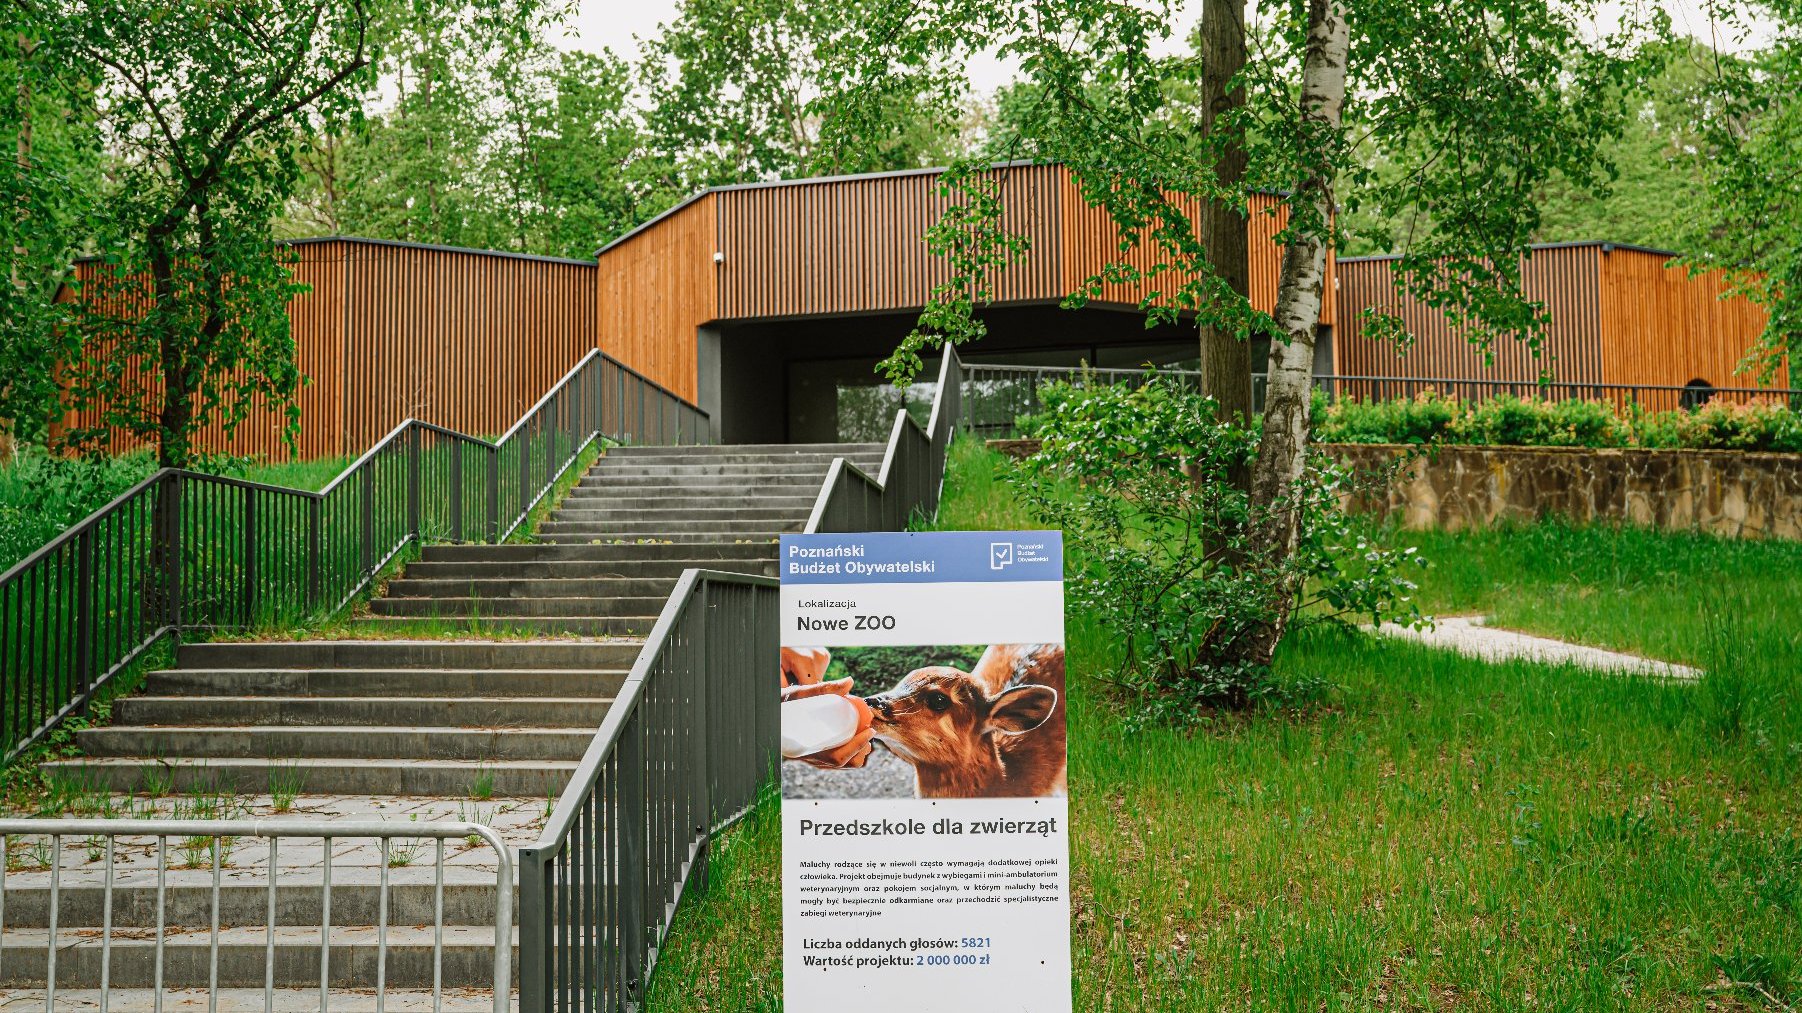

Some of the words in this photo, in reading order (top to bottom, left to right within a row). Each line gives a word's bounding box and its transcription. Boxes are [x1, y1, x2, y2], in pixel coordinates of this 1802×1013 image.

[790, 545, 864, 557] Poznański
[790, 562, 840, 573] Budżet
[845, 561, 934, 575] Obywatelski
[799, 600, 856, 609] Lokalizacja
[798, 617, 848, 630] Nowe
[855, 616, 895, 630] ZOO
[801, 819, 925, 835] Przedszkole
[933, 819, 962, 834] dla
[970, 818, 1057, 837] zwierząt
[800, 861, 830, 869] Maluchy
[835, 861, 862, 869] rodzące
[867, 860, 876, 869] się
[921, 860, 943, 868] często
[947, 860, 984, 868] wymagają
[988, 858, 1031, 867] dodatkowej
[1035, 858, 1057, 867] opieki
[799, 872, 838, 880] człowieka.
[840, 873, 865, 881] Projekt
[867, 872, 901, 881] obejmuje
[904, 872, 935, 880] budynek
[942, 872, 982, 880] wybiegami
[988, 870, 1057, 878] mini-ambulatorium
[801, 885, 859, 893] weterynaryjnym
[884, 885, 916, 893] pokojem
[921, 884, 959, 892] socjalnym,
[975, 883, 1000, 892] którym
[1005, 883, 1035, 891] maluchy
[1040, 882, 1058, 891] będą
[801, 897, 823, 906] mogły
[827, 897, 839, 905] być
[843, 896, 885, 905] bezpiecznie
[890, 896, 933, 904] odkarmiane
[957, 896, 1000, 904] przechodzić
[1004, 894, 1058, 904] specjalistyczne
[801, 909, 826, 918] zabiegi
[829, 910, 881, 918] weterynaryjne
[804, 939, 841, 949] Liczba
[846, 938, 906, 951] oddanych
[910, 938, 958, 951] głosów:
[962, 938, 989, 947] 5821
[803, 956, 853, 966] Wartość
[857, 955, 913, 968] projektu:
[916, 955, 924, 966] 2
[927, 955, 950, 965] 000
[953, 955, 976, 964] 000
[980, 954, 990, 964] zł
